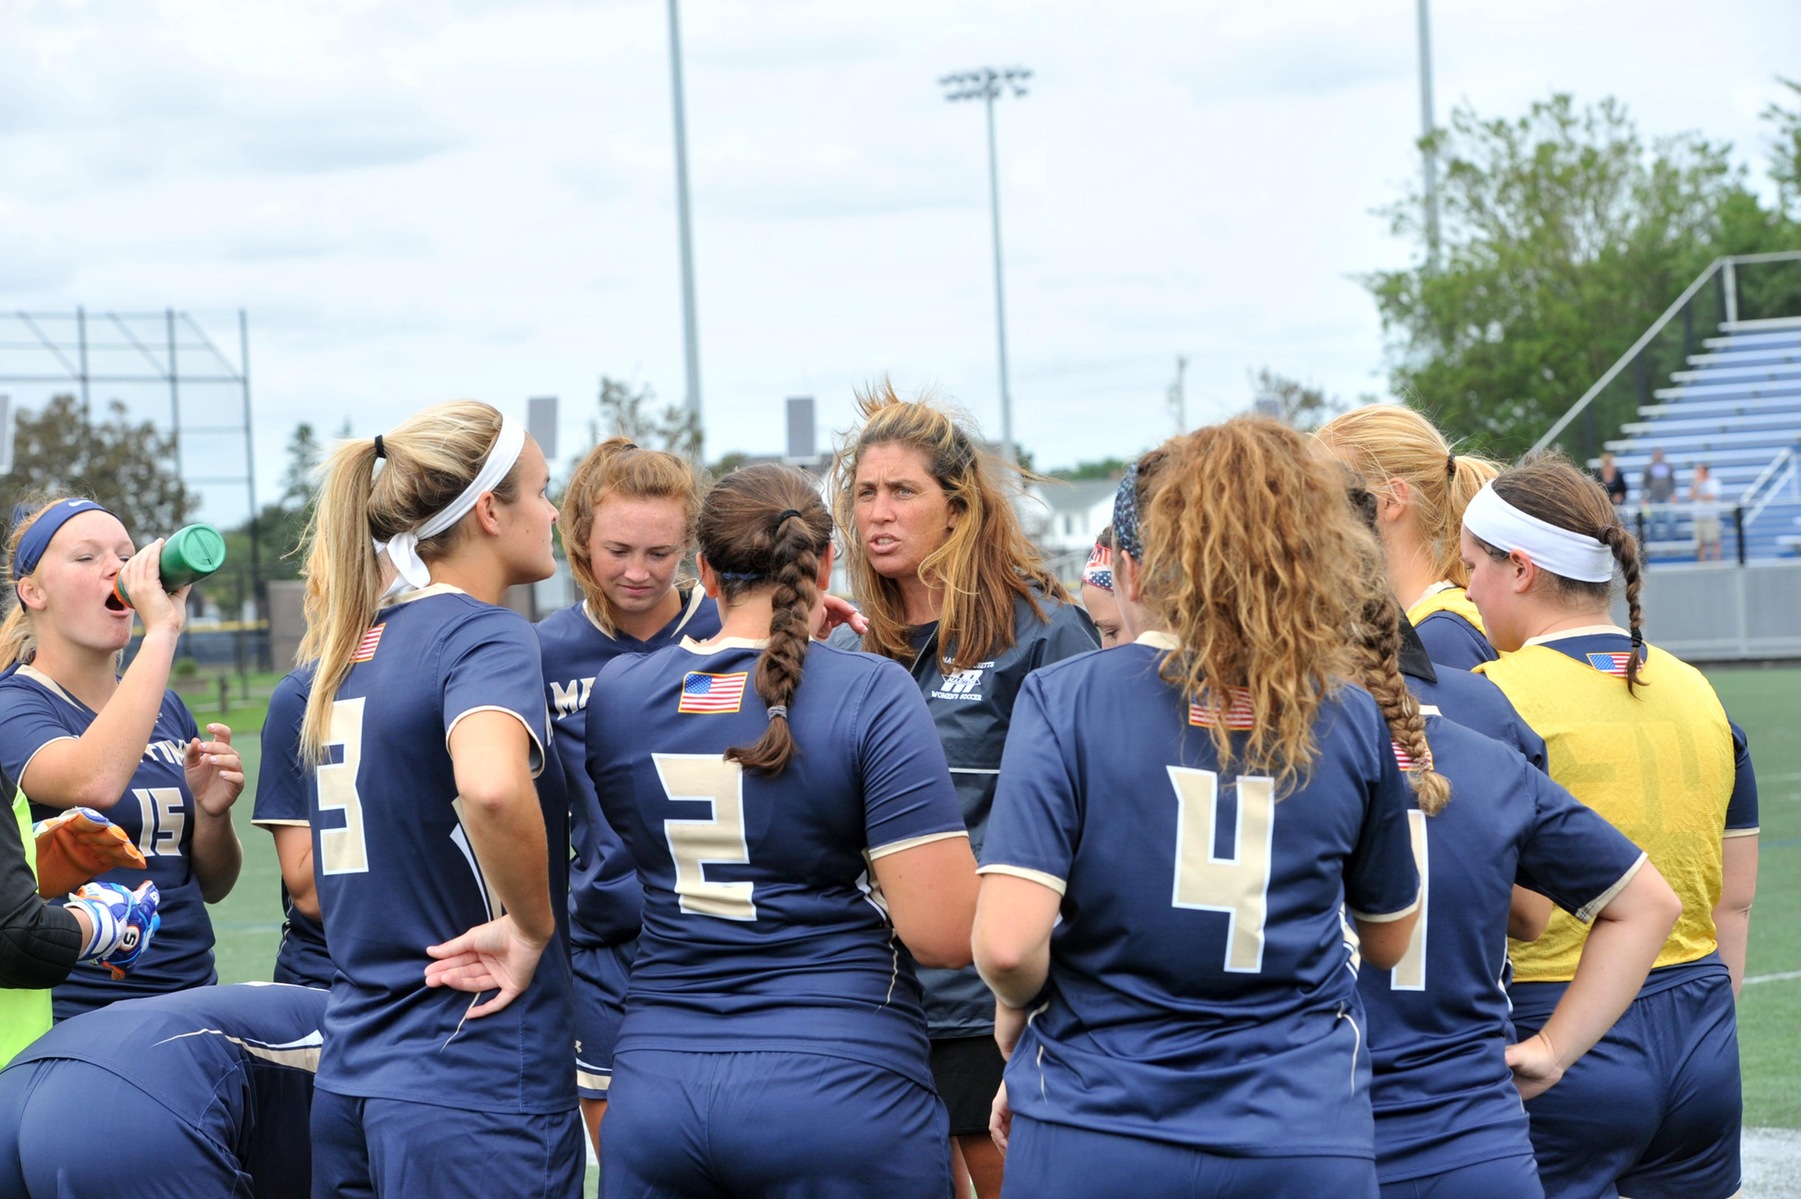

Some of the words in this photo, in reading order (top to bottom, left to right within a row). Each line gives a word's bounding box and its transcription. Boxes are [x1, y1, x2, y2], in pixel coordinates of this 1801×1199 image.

[132, 787, 185, 857] 15
[316, 697, 369, 875] 3
[651, 753, 757, 921] 2
[1166, 765, 1275, 973] 4
